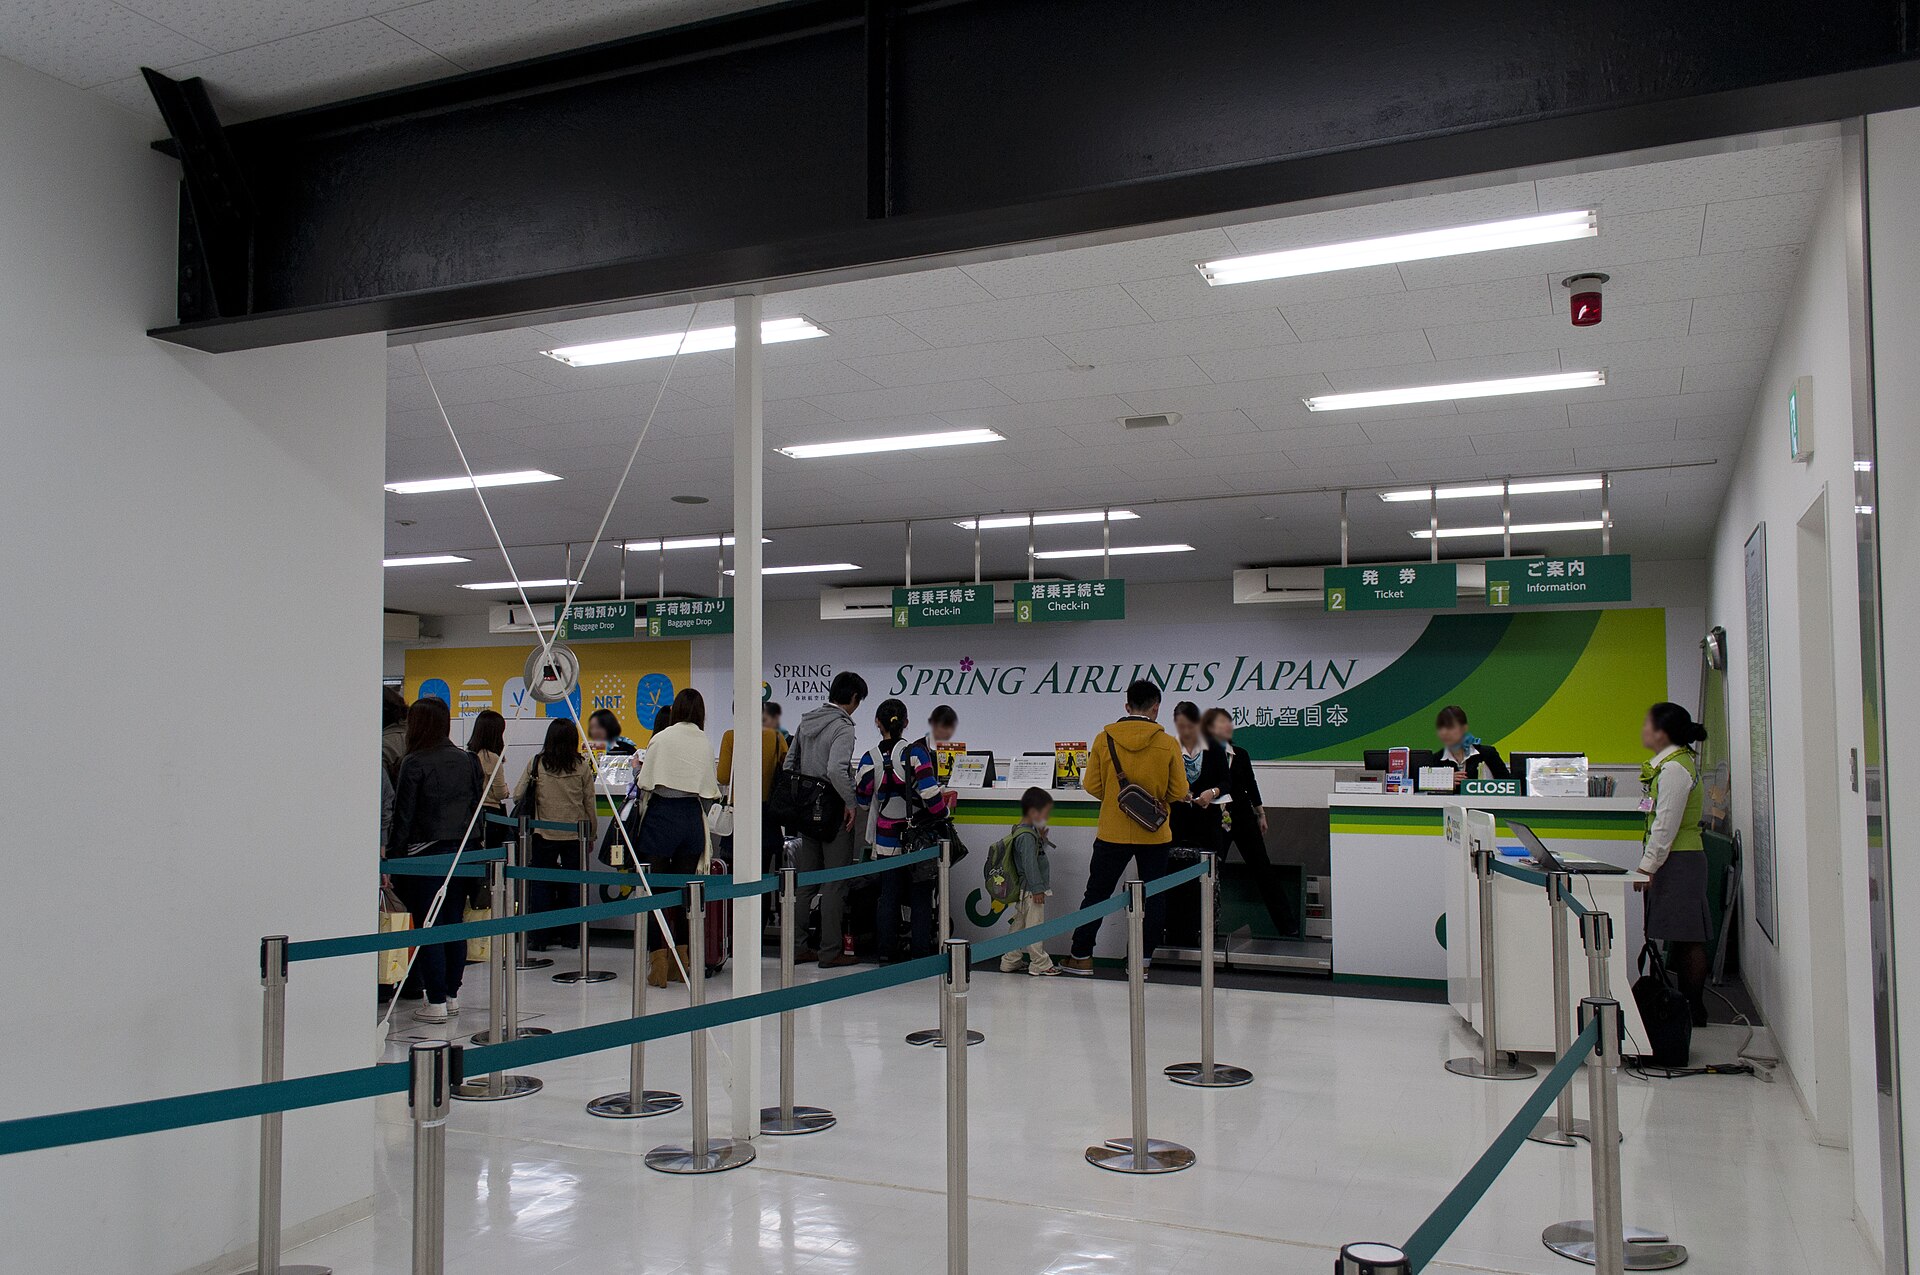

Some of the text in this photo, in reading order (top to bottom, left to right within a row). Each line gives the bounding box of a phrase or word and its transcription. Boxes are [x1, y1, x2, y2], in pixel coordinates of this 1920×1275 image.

[1527, 560, 1585, 577] ご案内
[1031, 583, 1106, 599] 搭乗手続き
[1527, 582, 1586, 593] Information
[907, 589, 976, 605] 搭乗手続き
[1331, 593, 1342, 610] 2
[1374, 590, 1404, 600] Ticket
[563, 605, 627, 620] 手荷物預かり
[655, 600, 726, 616] 手荷物預かり
[922, 606, 961, 617] Check-in
[1020, 605, 1029, 620] 3
[1047, 601, 1090, 612] Check-in
[667, 618, 713, 629] Baggage Drop
[897, 611, 906, 625] 4
[559, 625, 566, 638] 6
[573, 622, 615, 632] Baggage Drop
[651, 621, 659, 635] 5
[774, 663, 832, 678] SPRING
[889, 655, 1359, 701] SPRING AIRLINES JAPAN
[785, 679, 831, 698] JAPAN
[594, 695, 622, 709] NRT
[1231, 703, 1349, 727] 秋航空日本
[1466, 782, 1515, 794] CLOSE
